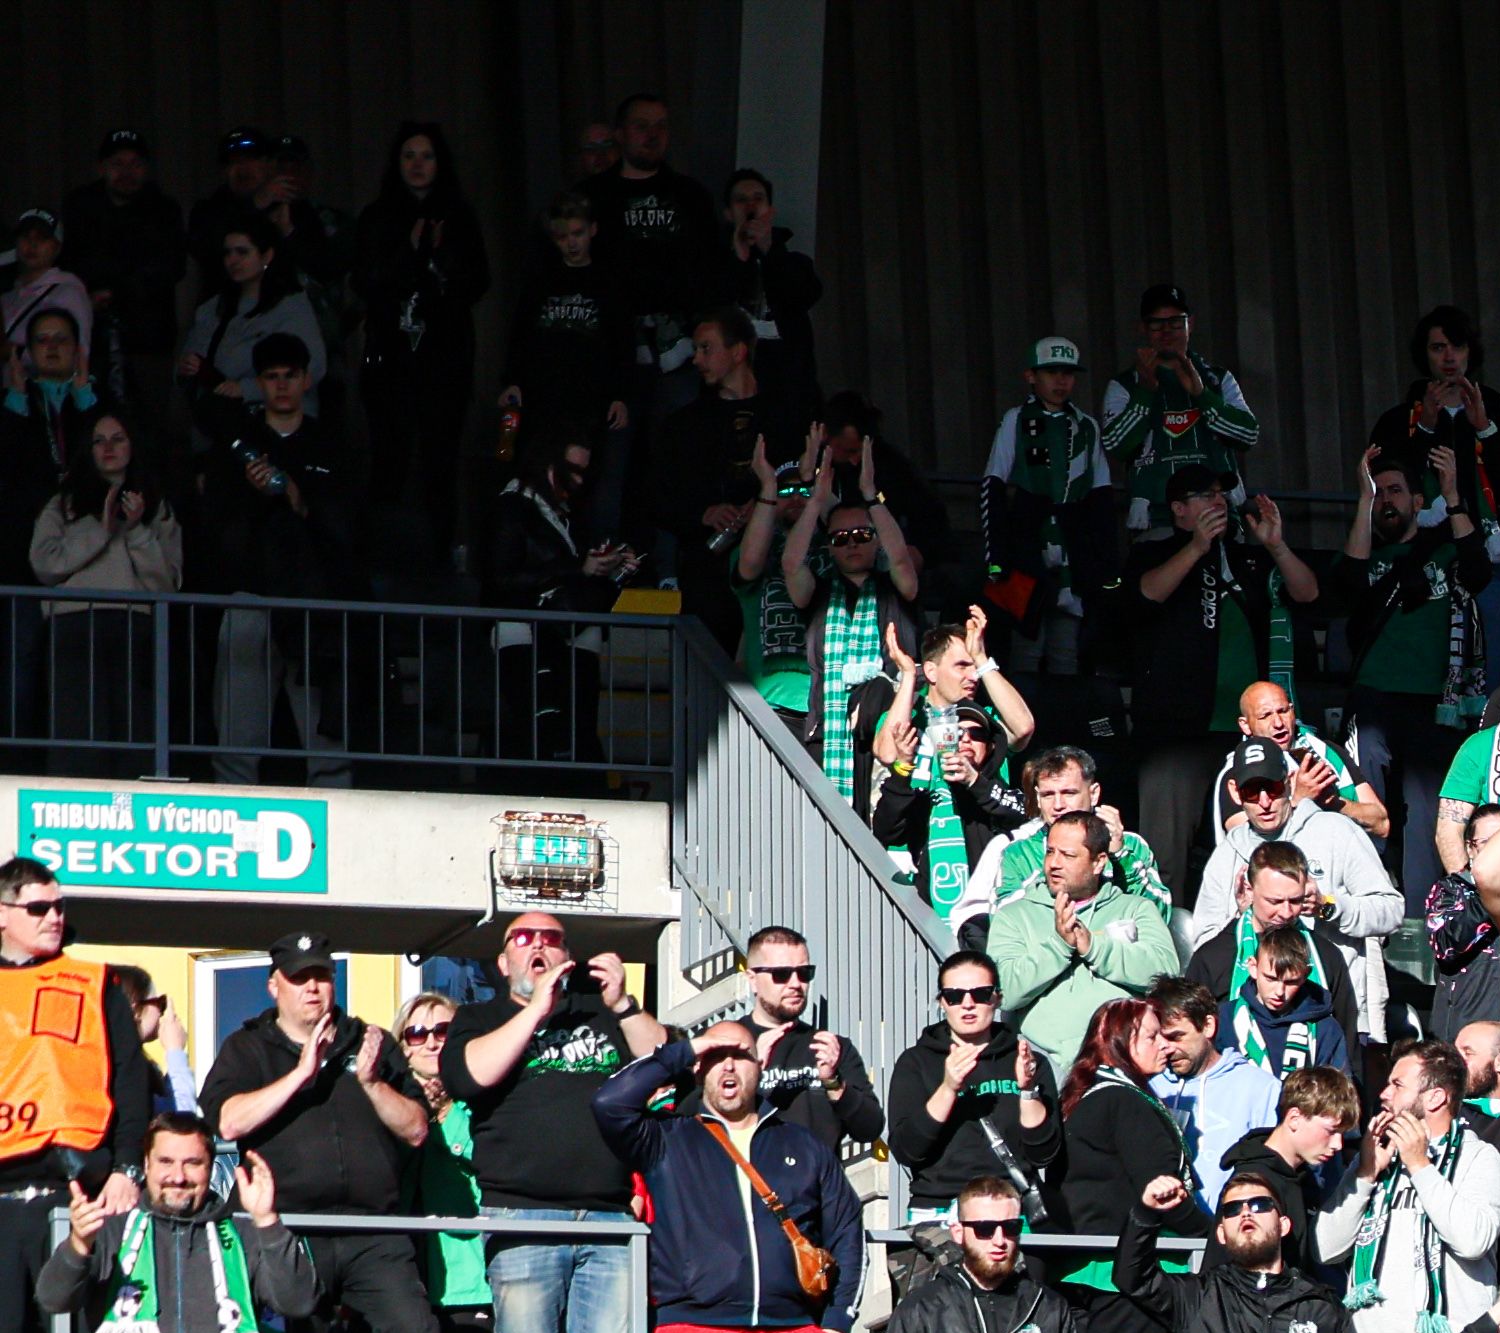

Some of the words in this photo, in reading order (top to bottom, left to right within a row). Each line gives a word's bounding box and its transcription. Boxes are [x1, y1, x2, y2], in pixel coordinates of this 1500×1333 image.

[32, 802, 134, 833] TRIBUNA
[146, 803, 238, 835] VÝCHOD
[32, 840, 238, 880] SEKTOR
[257, 811, 313, 880] D
